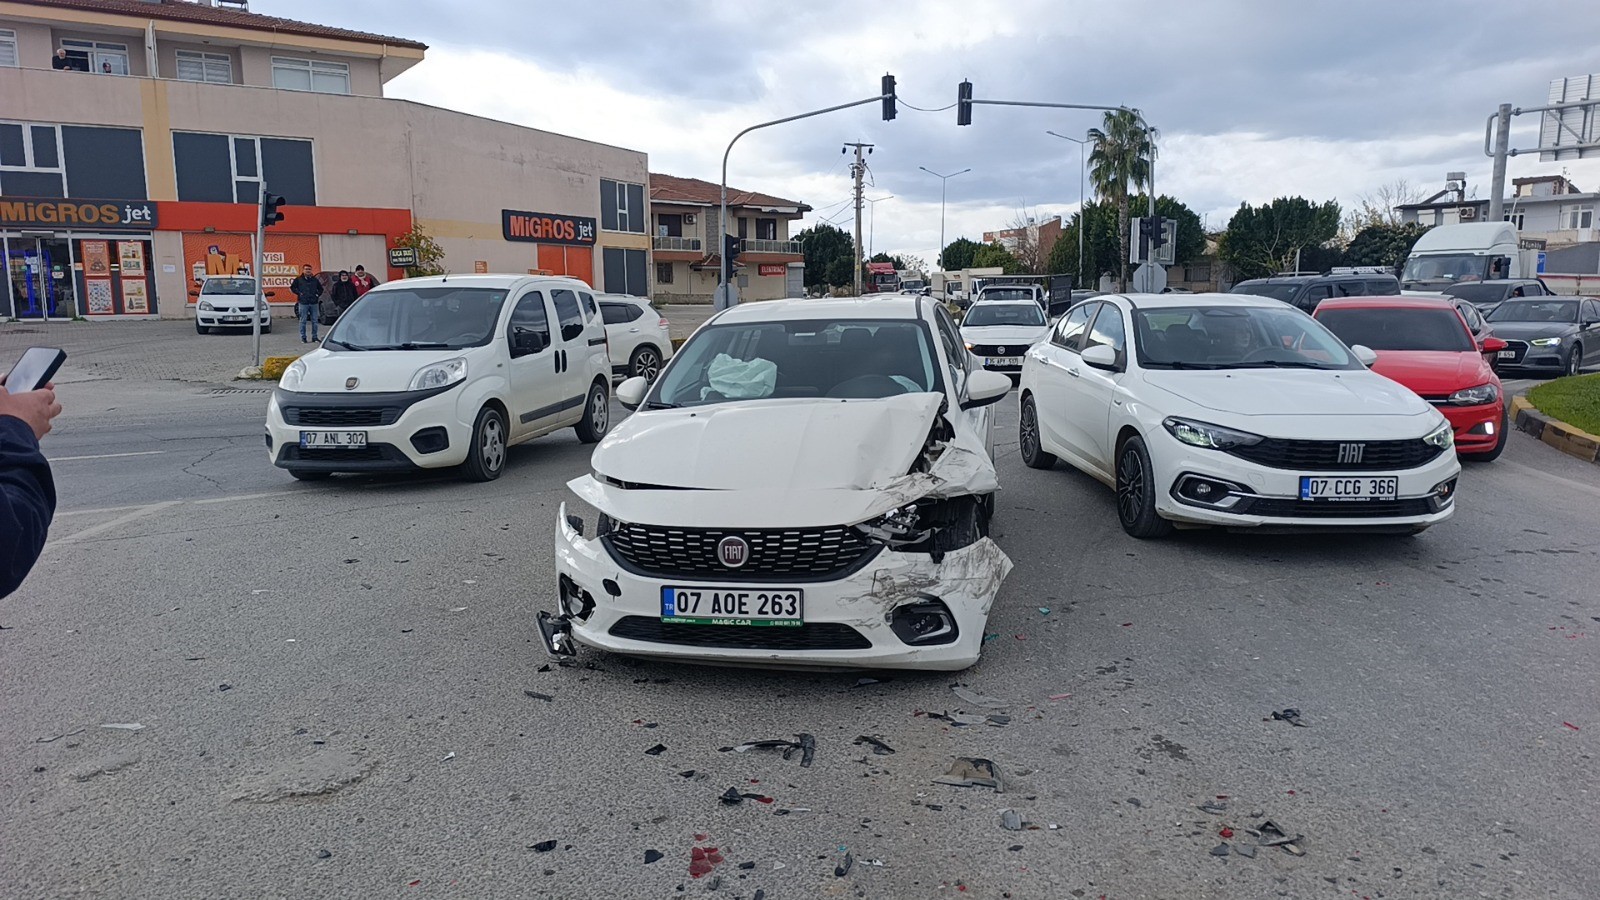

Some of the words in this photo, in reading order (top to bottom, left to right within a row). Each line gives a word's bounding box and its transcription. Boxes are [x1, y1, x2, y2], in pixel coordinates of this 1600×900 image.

[122, 204, 151, 224] jet
[577, 221, 592, 240] jet
[306, 433, 317, 444] 07
[324, 433, 342, 444] ANL
[346, 433, 364, 444] 302
[1337, 443, 1365, 463] FIAT
[1311, 480, 1328, 495] 07
[1335, 480, 1361, 495] CCG
[1369, 480, 1395, 495] 366
[724, 545, 742, 560] FIAT
[677, 592, 701, 613] 07
[711, 593, 749, 614] AOE
[757, 594, 797, 615] 263
